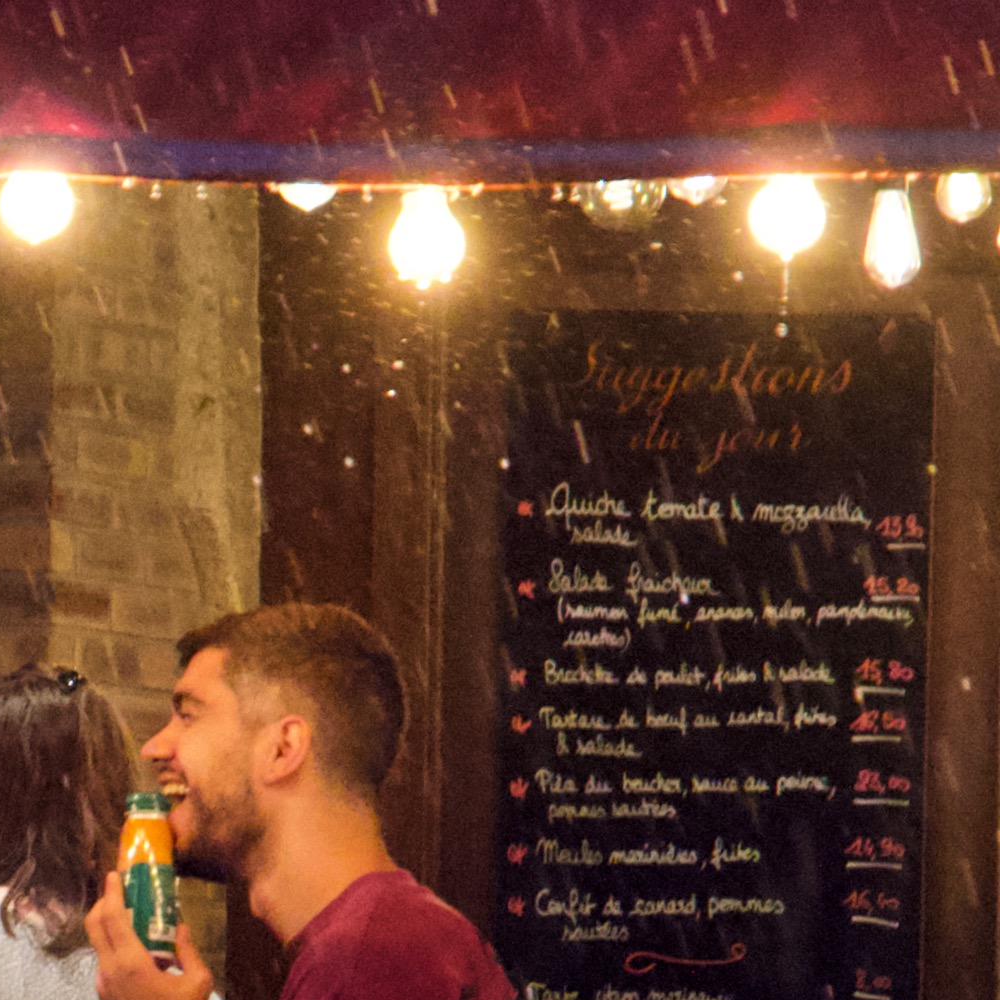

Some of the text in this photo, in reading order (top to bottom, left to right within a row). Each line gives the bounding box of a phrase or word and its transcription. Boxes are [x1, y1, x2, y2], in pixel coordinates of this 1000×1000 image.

[584, 342, 852, 416] Suggestions
[694, 424, 804, 474] jour
[545, 480, 631, 531] Quiche
[639, 488, 722, 521] tomate
[570, 519, 638, 547] salade
[548, 557, 615, 593] Salade
[626, 666, 647, 685] de
[693, 714, 720, 729] au
[535, 887, 597, 926] Confit
[603, 894, 624, 917] de
[707, 896, 785, 920] pommes
